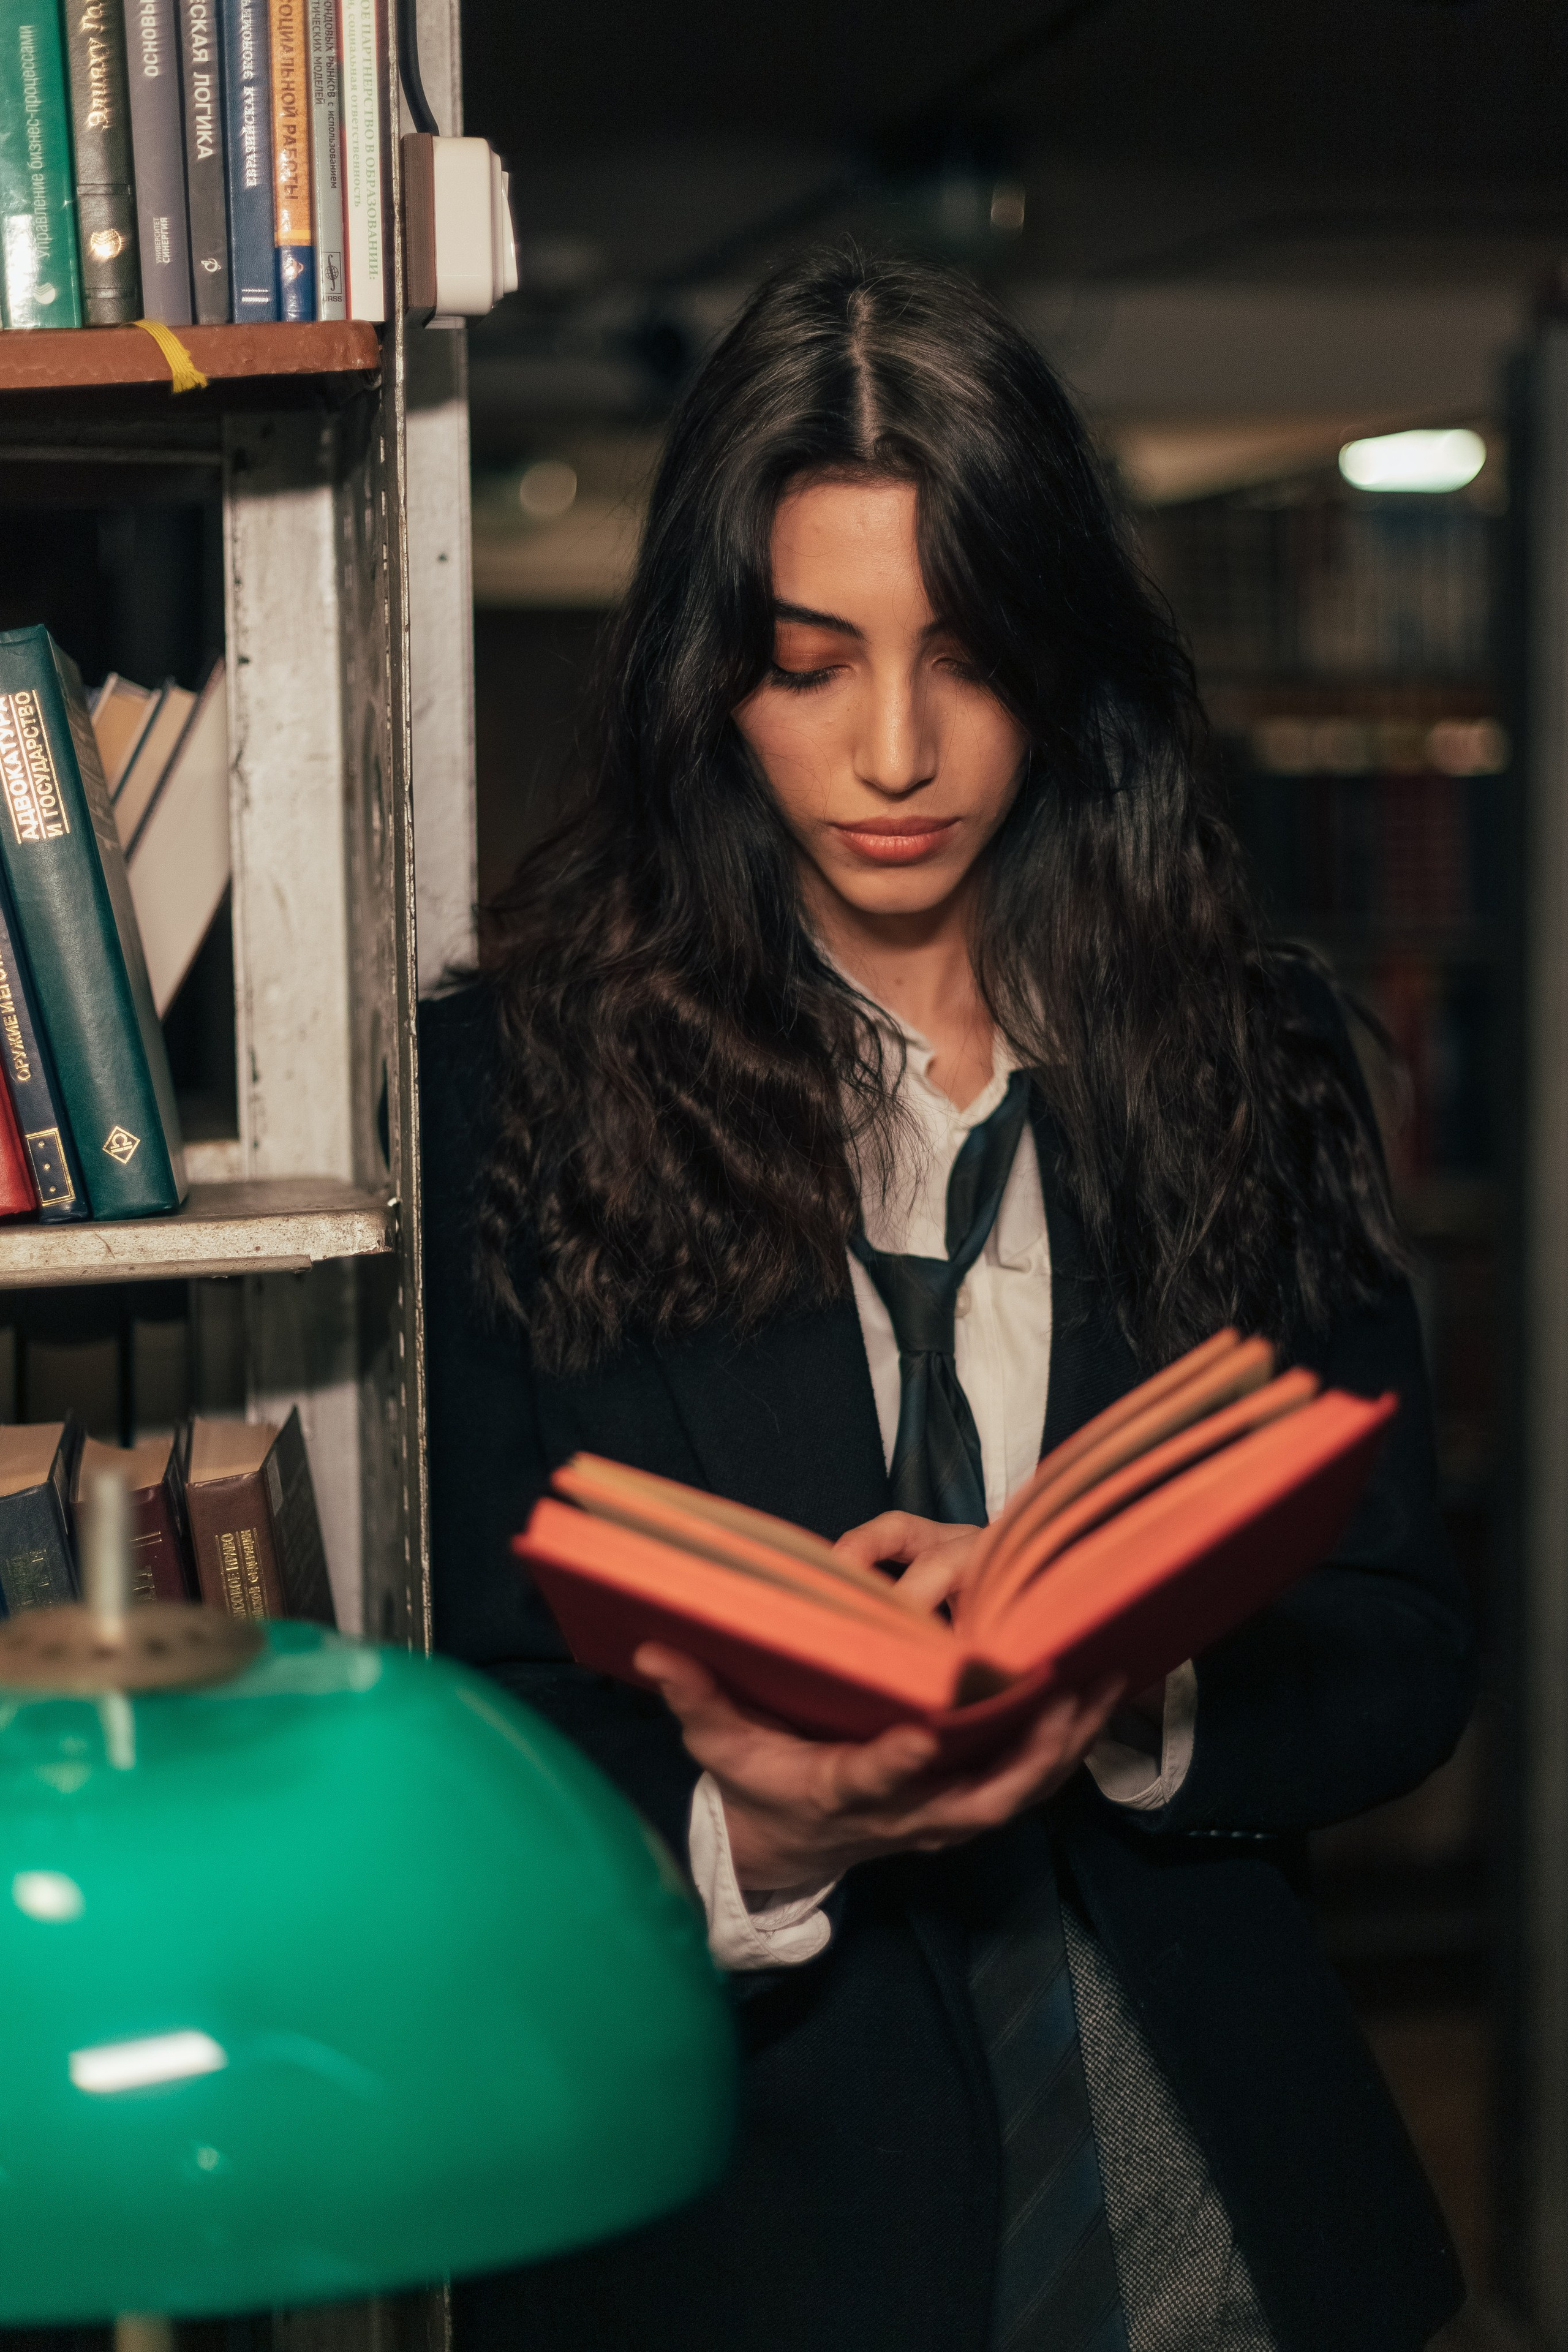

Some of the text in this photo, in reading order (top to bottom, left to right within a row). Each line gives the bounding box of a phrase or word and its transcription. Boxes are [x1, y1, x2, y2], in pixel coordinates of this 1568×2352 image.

[140, 0, 159, 77] ОСНОВЫ
[311, 1, 325, 105] ТИЧЕСКИХ МОДЕЛЕЙ
[323, 0, 334, 52] ОНДОВЫХ
[348, 13, 358, 91] социальная
[189, 0, 213, 160] СКАЯ ЛОГИКА
[277, 0, 298, 199] ОЦИАЛЬНОЙ РАБОТЫ
[326, 56, 336, 98] РЫНКОВ
[361, 24, 375, 141] ПАРТНЕРСТВО
[19, 25, 53, 258] Управление бизнес-процессами
[241, 86, 257, 187] ЕВРАЗИЙСКАЯ
[328, 110, 337, 189] использованием
[350, 94, 361, 208] ответственность
[153, 217, 162, 263] УНИВЕРСИТЕТ
[160, 217, 170, 263] СИНЕРГИЯ
[366, 157, 379, 280] ОБРАЗОВАНИИ:
[14, 692, 64, 838] И ГОСУДАРСТВО
[0, 1000, 15, 1014] И
[3, 1014, 31, 1081] ОРУЖИЕ
[221, 1533, 239, 1570] ПРАВО
